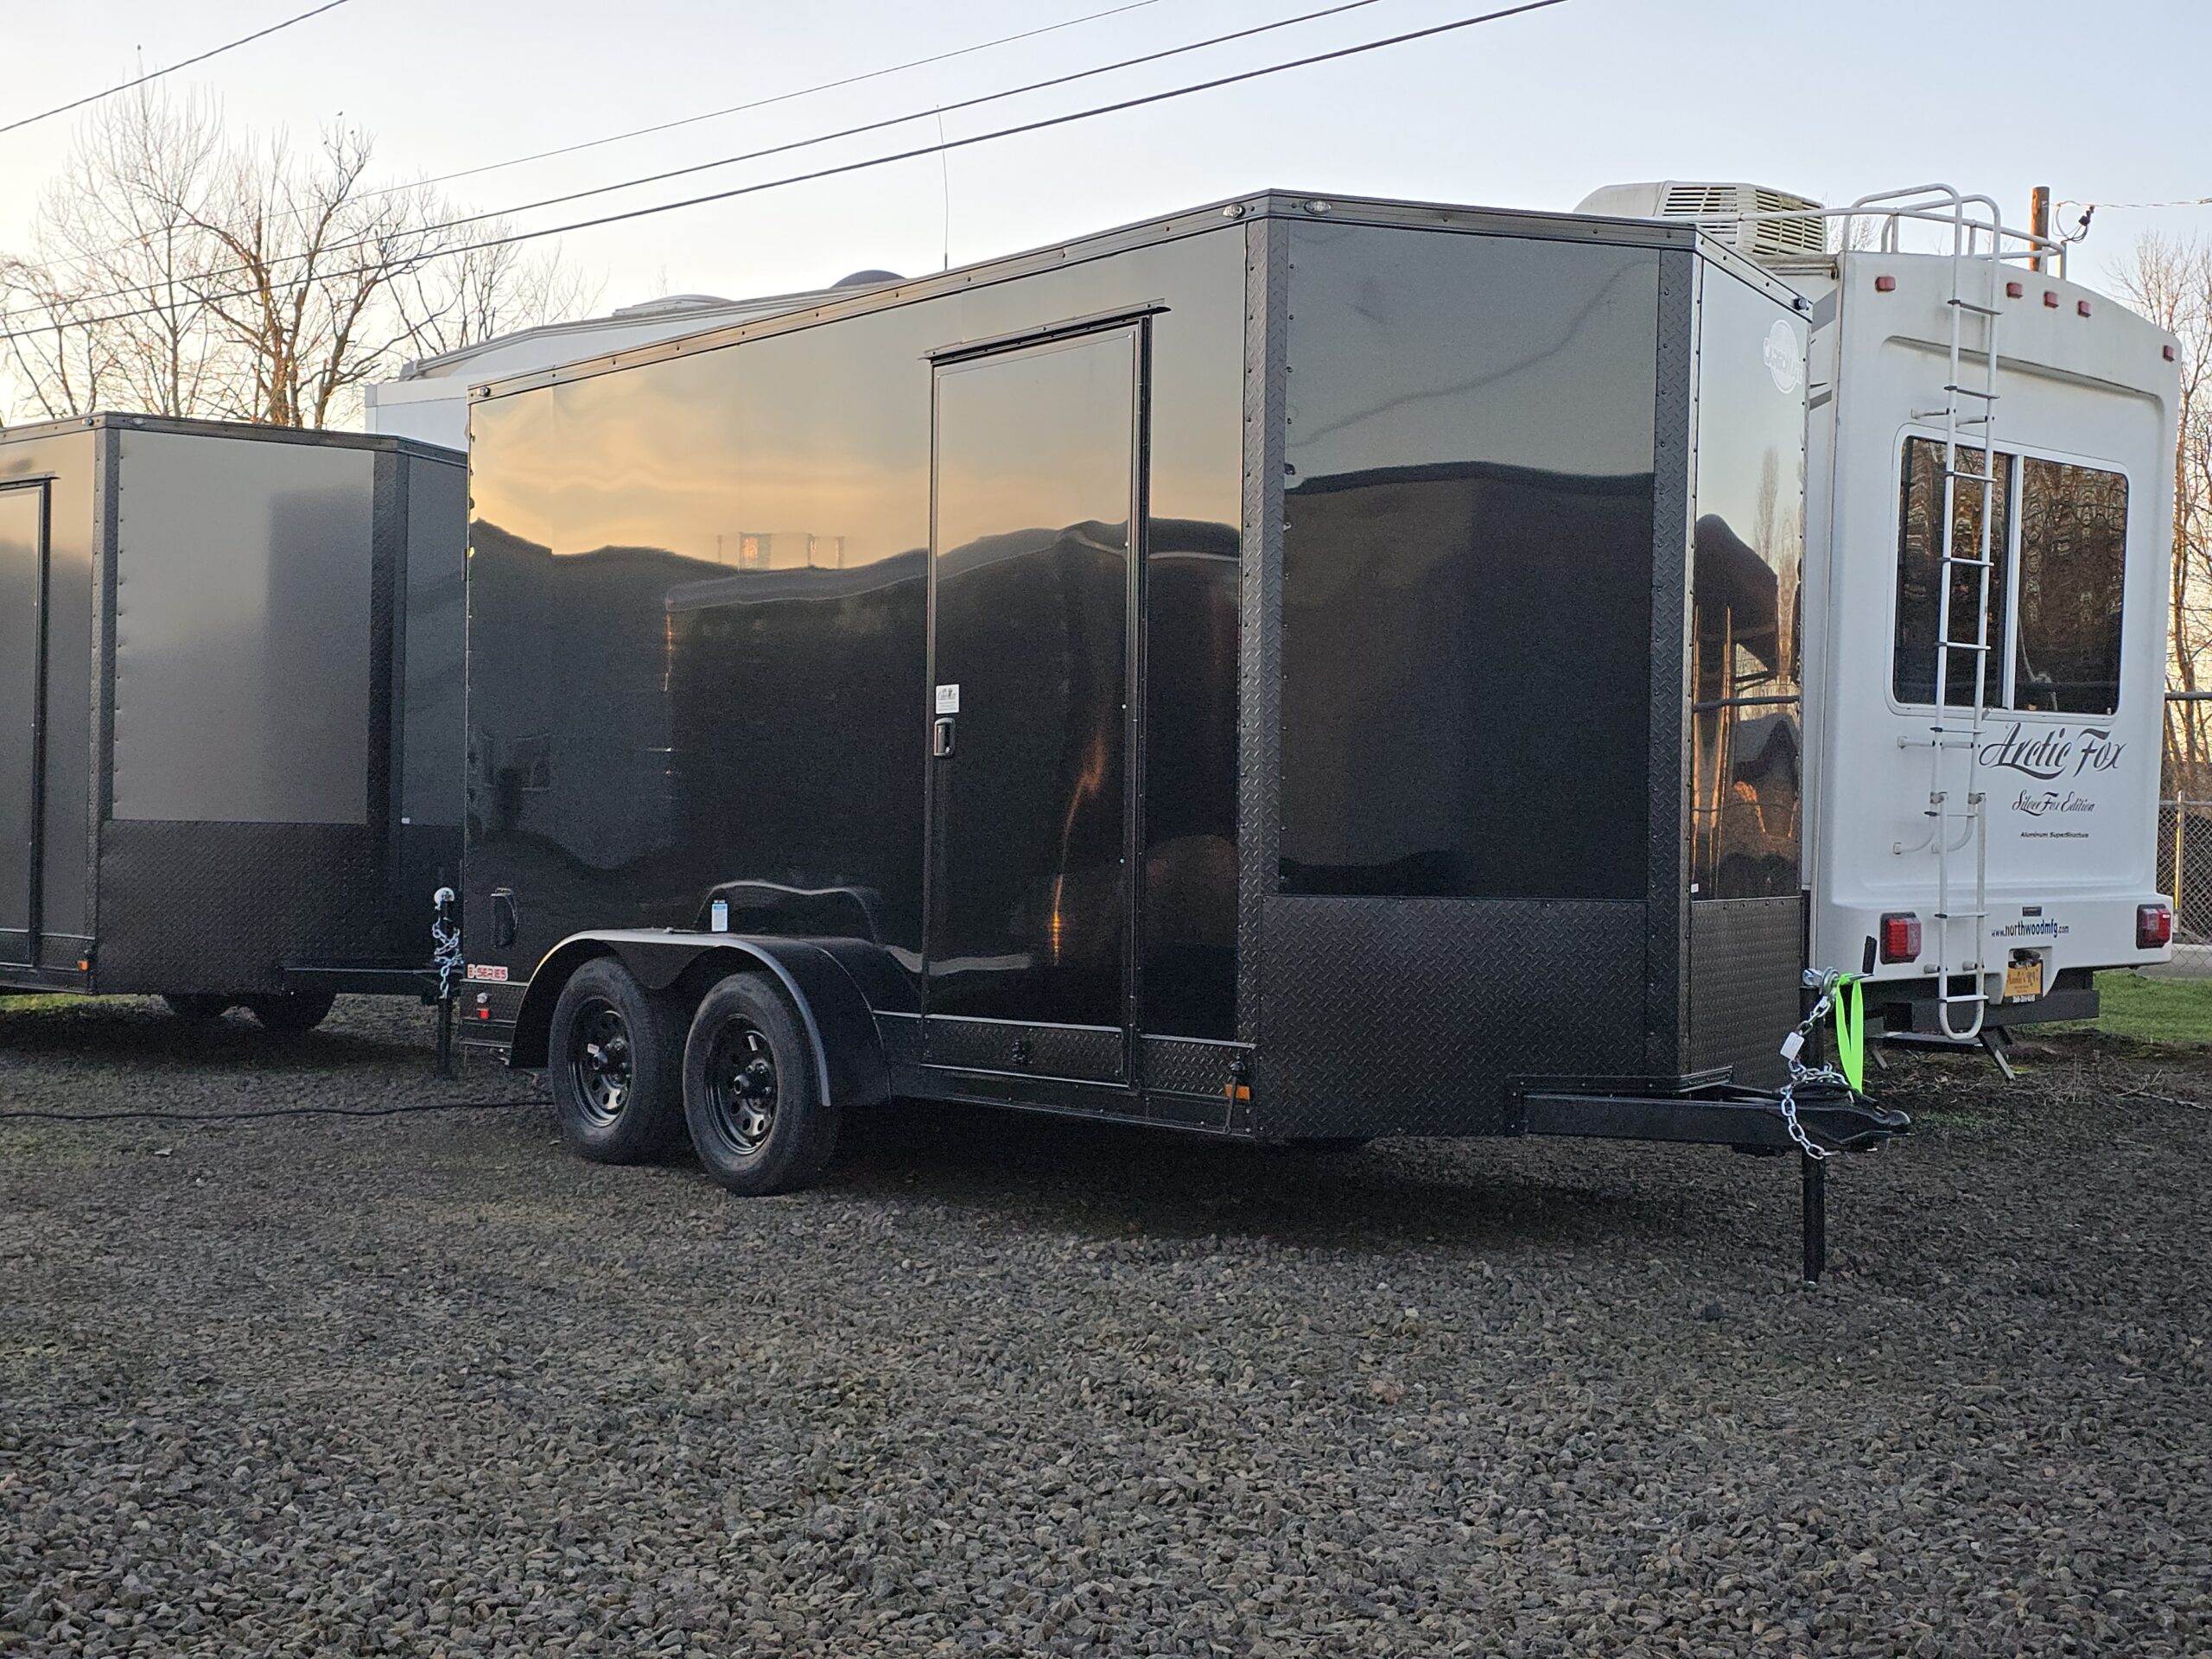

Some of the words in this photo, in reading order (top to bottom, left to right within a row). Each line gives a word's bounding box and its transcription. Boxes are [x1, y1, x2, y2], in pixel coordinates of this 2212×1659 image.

[1979, 722, 2072, 780] Arctic
[2074, 728, 2127, 778] Fox
[2012, 789, 2044, 817] Silver
[2040, 791, 2060, 812] Fox
[2061, 791, 2095, 813] Edition
[1990, 918, 2069, 938] www.northwoodmfg.com
